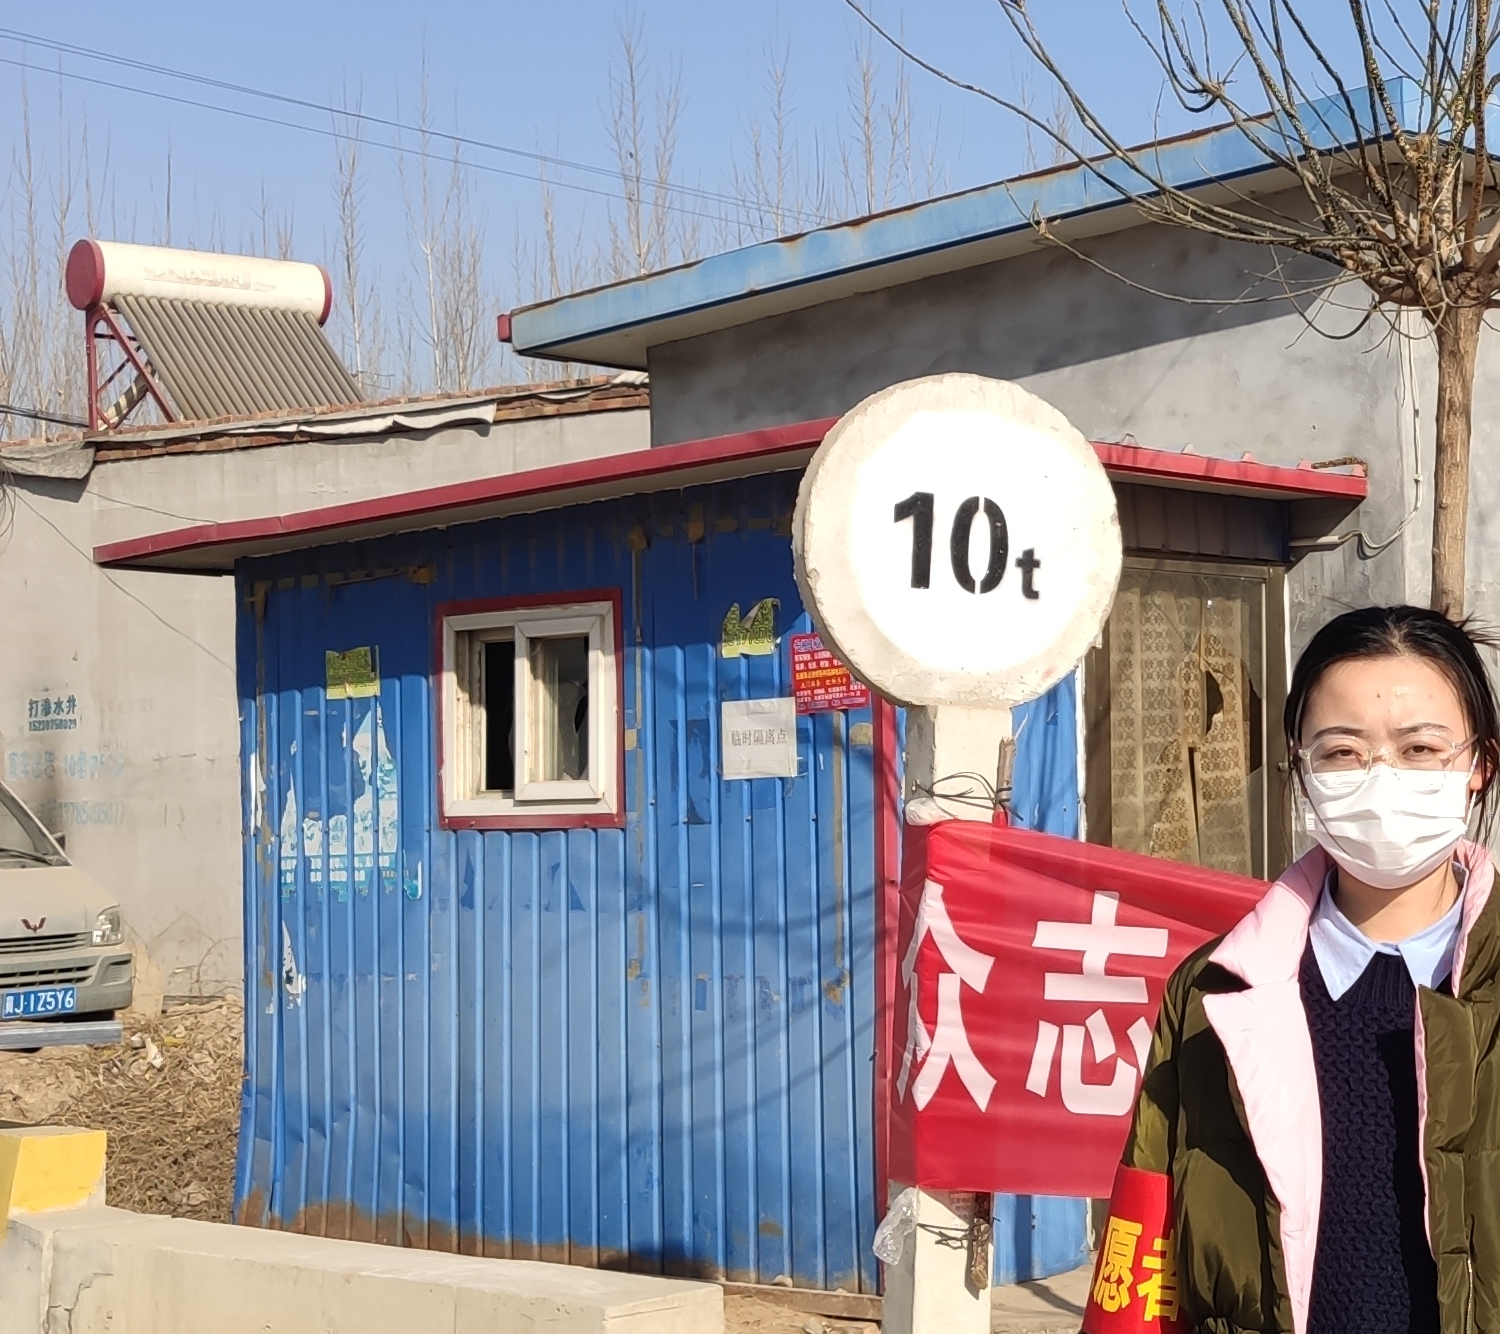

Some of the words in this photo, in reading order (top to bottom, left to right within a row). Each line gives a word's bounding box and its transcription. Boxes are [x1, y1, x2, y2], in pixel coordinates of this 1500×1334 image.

[893, 491, 1041, 600] 10t
[730, 728, 787, 747] 临时隔离点
[896, 878, 1168, 1117] 众志
